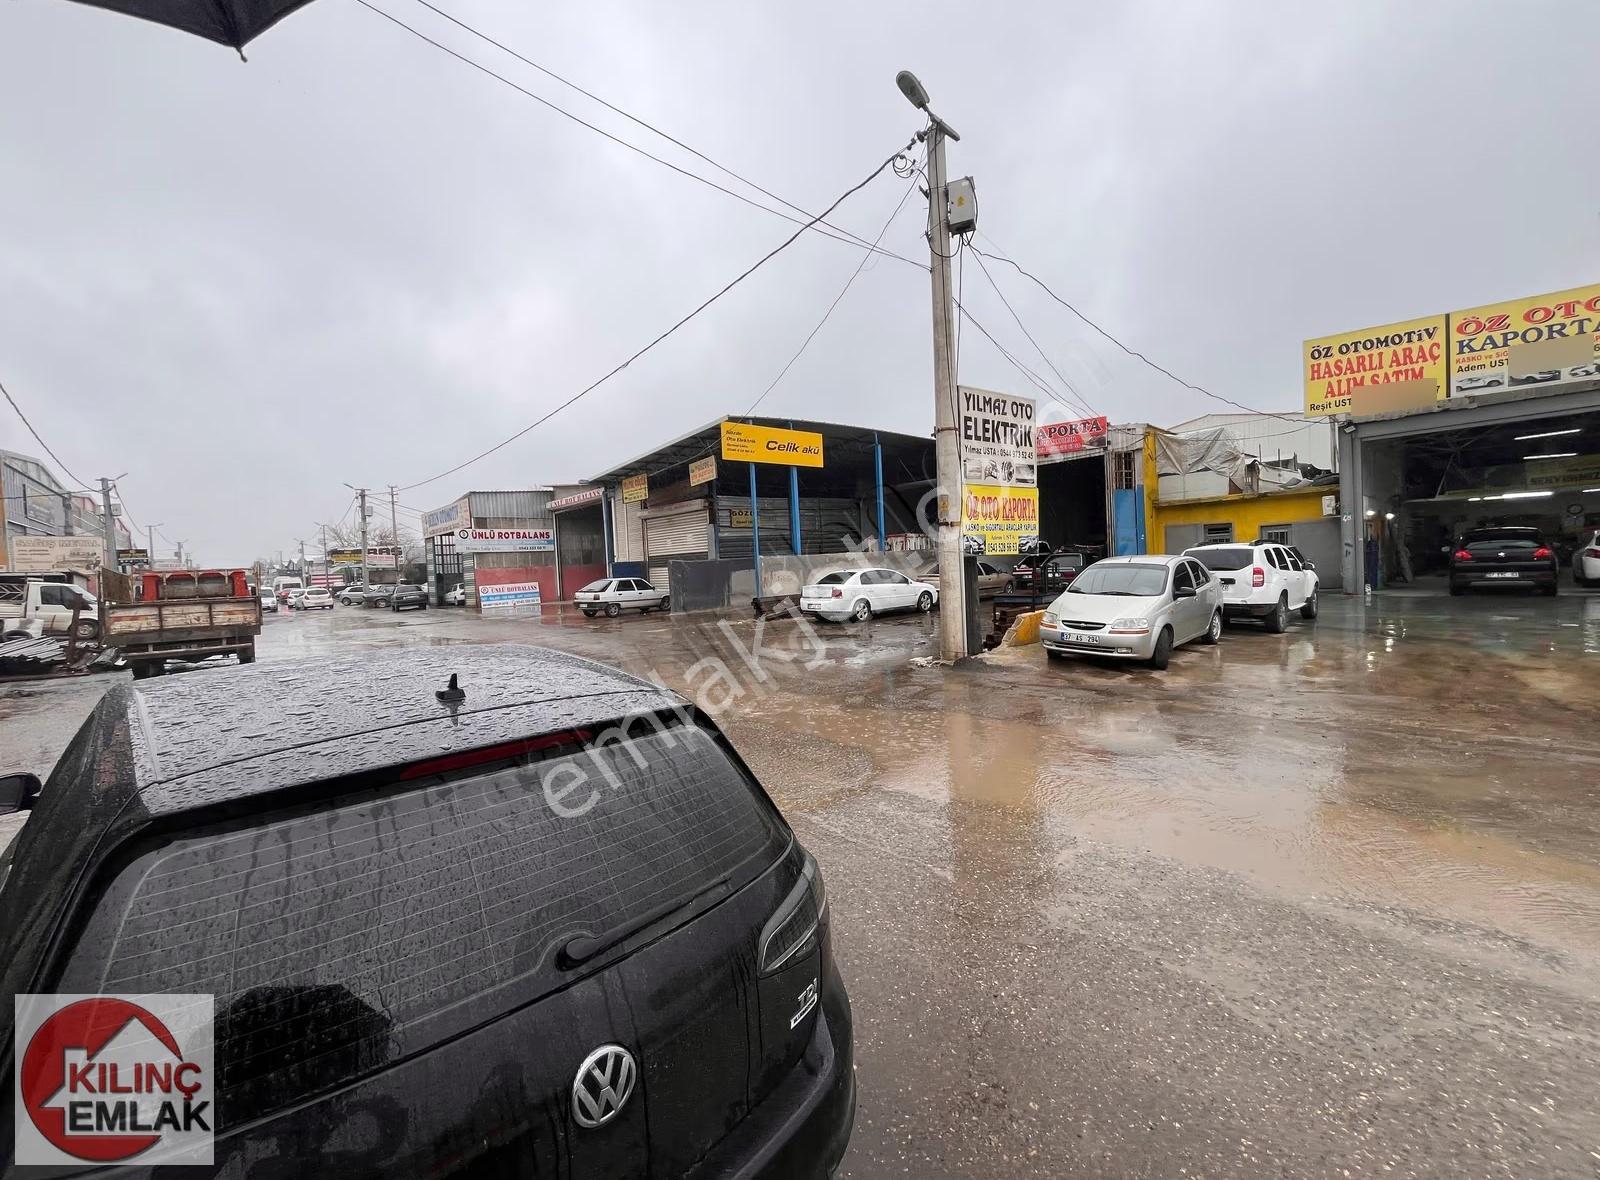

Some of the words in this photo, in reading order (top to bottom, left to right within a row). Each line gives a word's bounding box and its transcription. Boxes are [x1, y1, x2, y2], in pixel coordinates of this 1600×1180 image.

[1456, 313, 1511, 336] ÖZ
[1310, 345, 1334, 360] ÖZ
[1310, 351, 1384, 381] HASARLI
[1389, 342, 1441, 368] ARAÇ
[1457, 364, 1486, 373] Adem
[1490, 358, 1509, 368] UST
[1325, 375, 1366, 399] ALIM
[1370, 366, 1424, 385] SATIM
[964, 392, 1007, 415] YILMAZ
[1010, 401, 1033, 420] OTO
[1310, 401, 1332, 412] Reşit
[1335, 397, 1352, 408] UST
[802, 446, 820, 455] akü
[983, 447, 996, 456] USTA
[980, 495, 999, 521] OTO
[1002, 497, 1036, 521] KAPORTA
[471, 529, 496, 540] ÜNLÜ
[497, 531, 550, 540] ROTBALANS
